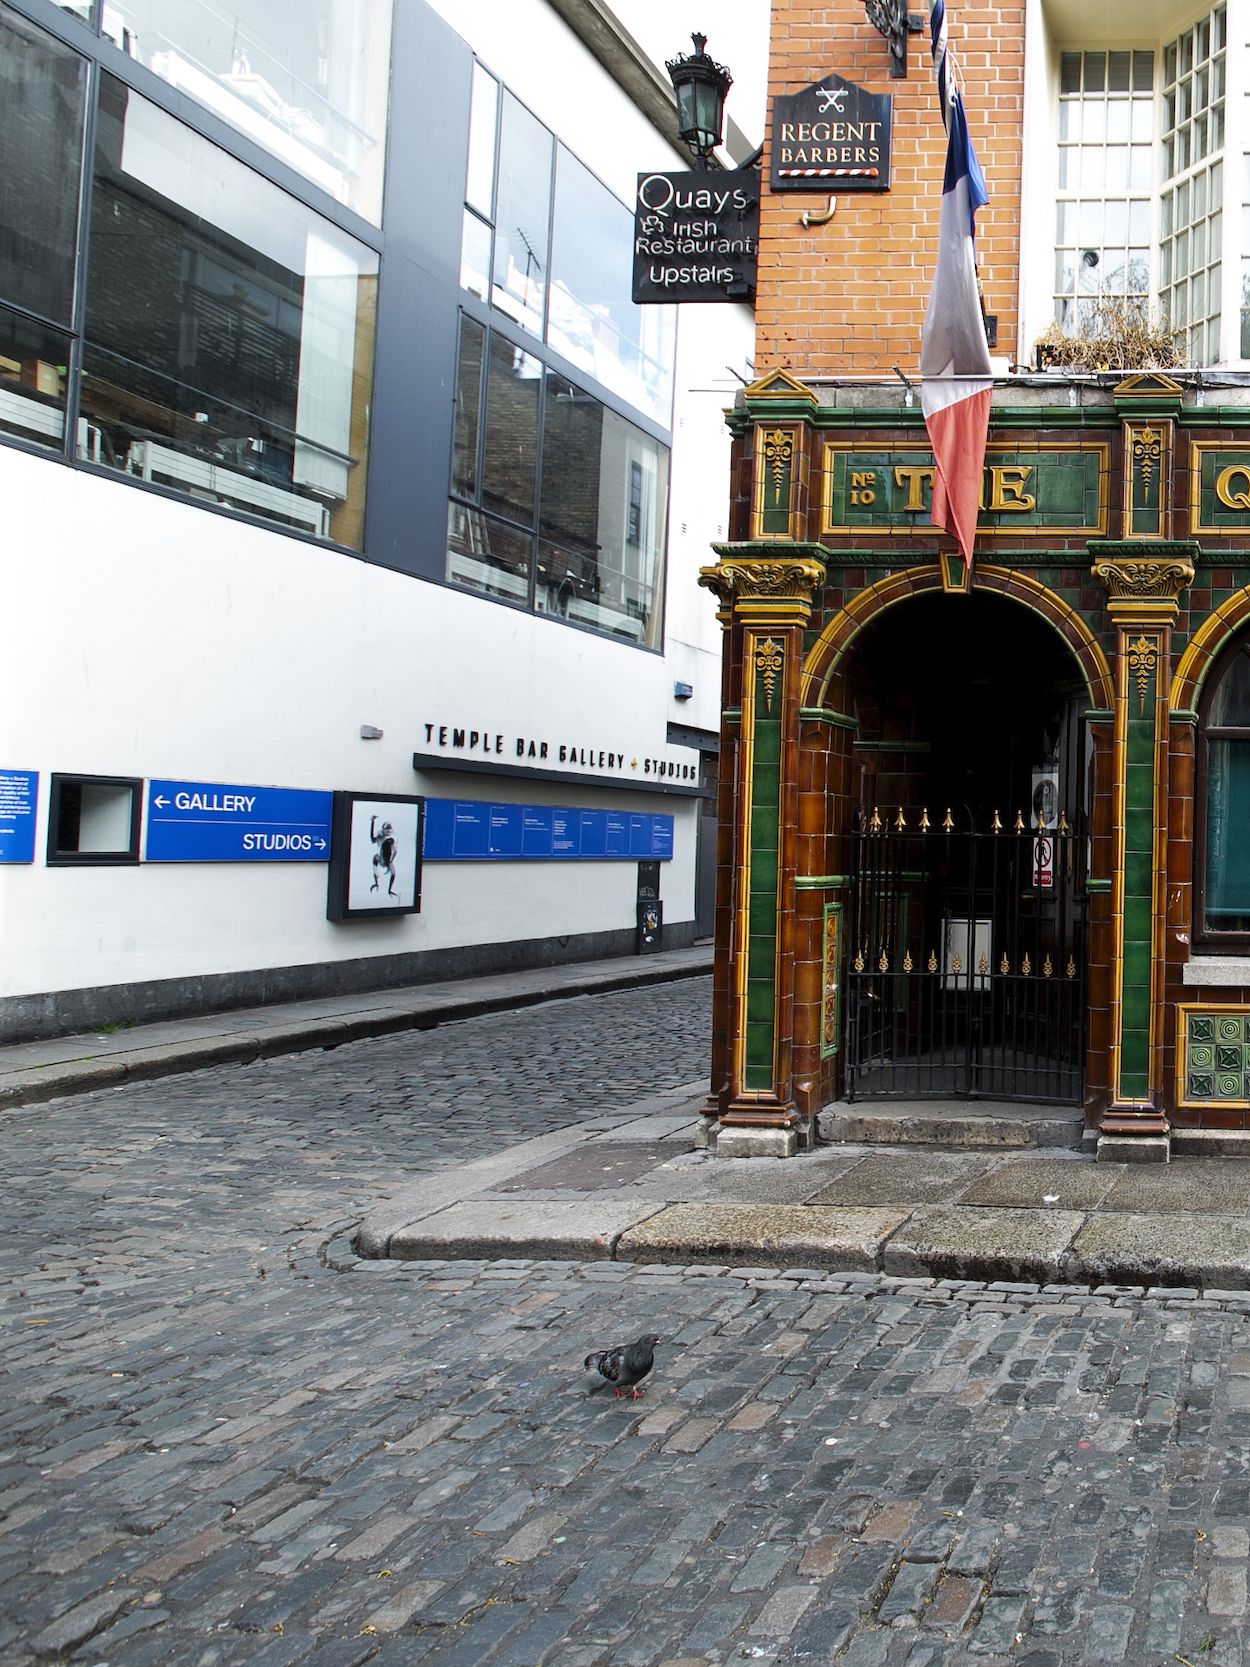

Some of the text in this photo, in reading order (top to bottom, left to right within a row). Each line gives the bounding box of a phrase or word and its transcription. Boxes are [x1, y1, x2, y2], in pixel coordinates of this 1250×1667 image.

[780, 122, 882, 142] REGENT
[780, 147, 881, 163] BARBERS
[639, 174, 748, 217] Quays
[673, 220, 717, 238] Irish
[636, 236, 752, 254] Restaurant
[894, 466, 1036, 512] TE
[424, 723, 504, 754] TEMPLE
[516, 738, 548, 759] BAR
[559, 745, 624, 769] GALLERY
[644, 758, 696, 780] STUDIOS
[175, 792, 256, 813] GALLERY
[243, 833, 312, 850] STUDIOS
